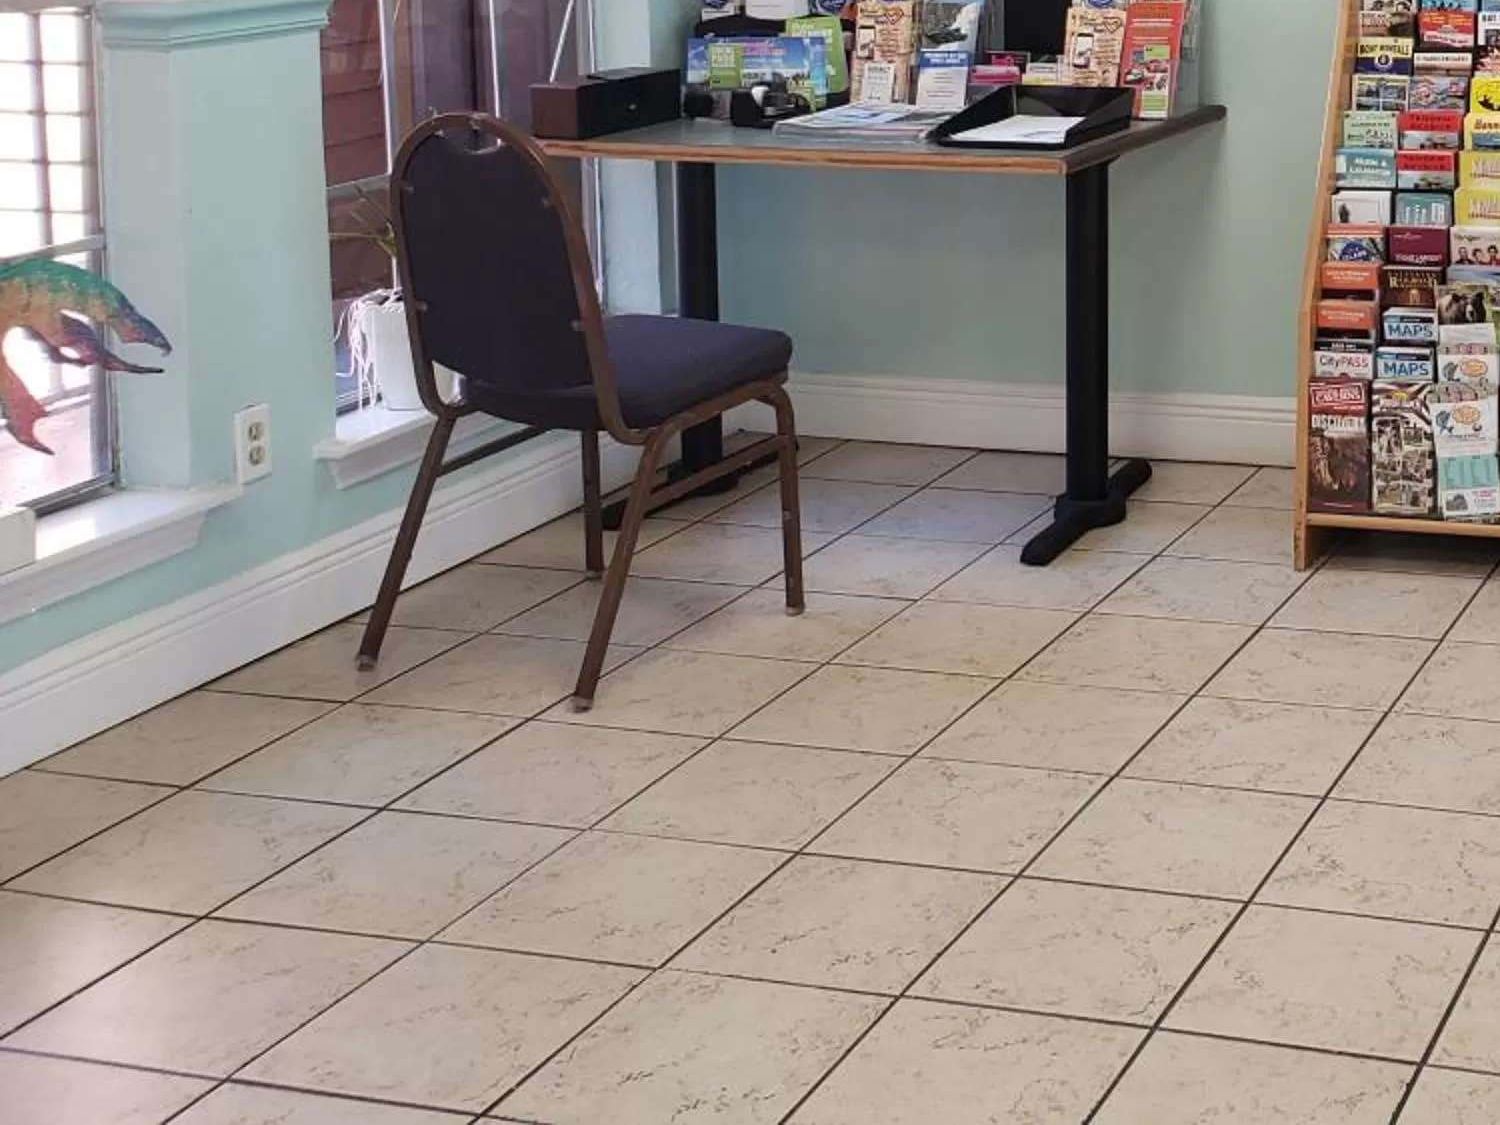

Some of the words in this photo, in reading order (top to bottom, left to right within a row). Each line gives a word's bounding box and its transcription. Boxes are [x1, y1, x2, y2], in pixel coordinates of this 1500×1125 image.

[1388, 323, 1433, 337] MAPS
[1319, 354, 1369, 368] CityPASS
[1384, 362, 1429, 376] MAPS
